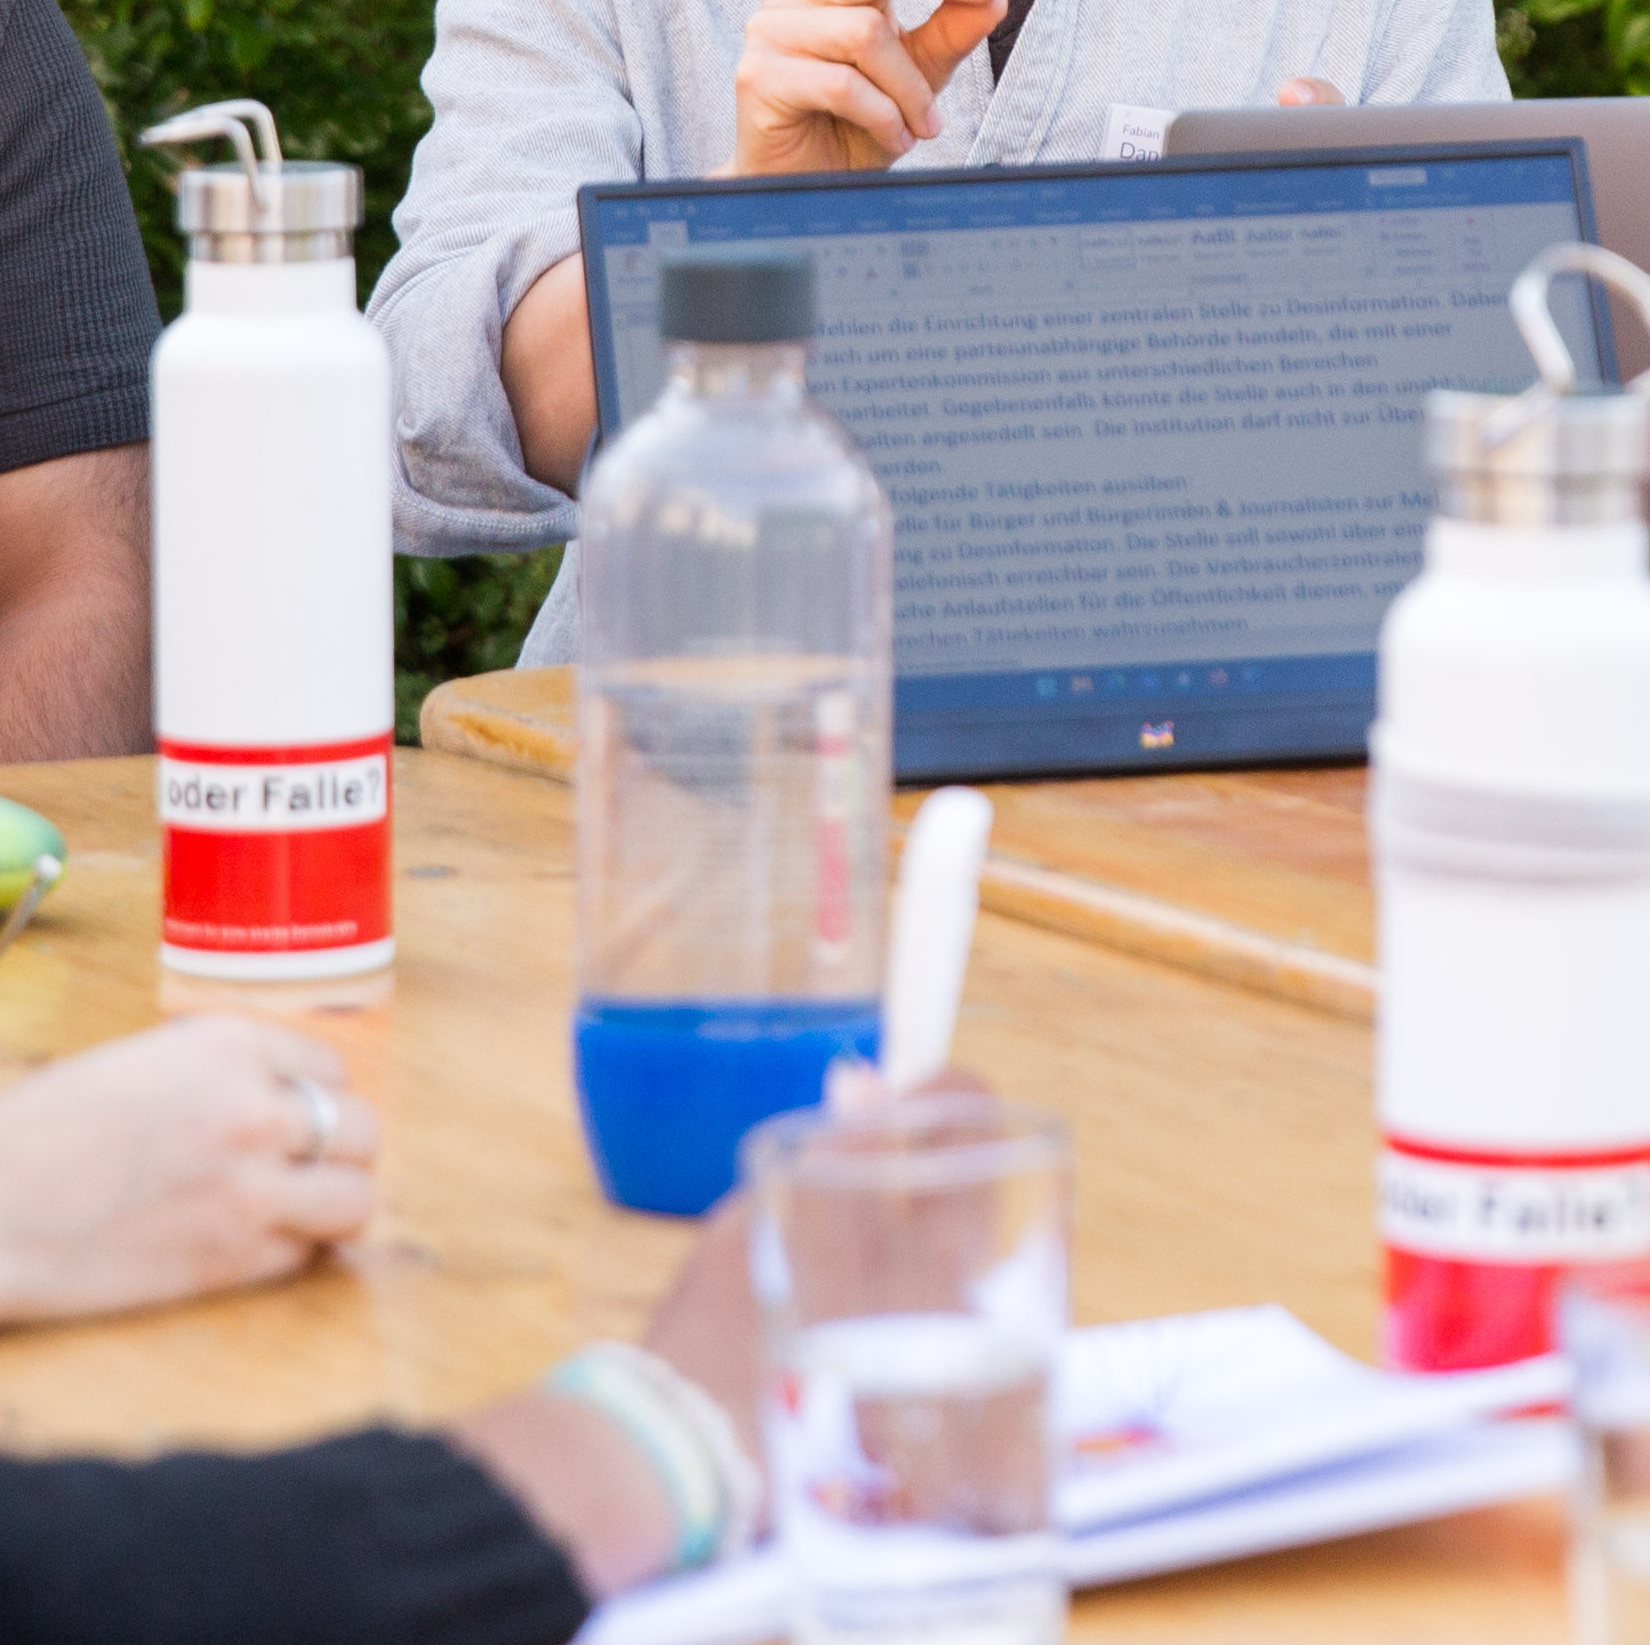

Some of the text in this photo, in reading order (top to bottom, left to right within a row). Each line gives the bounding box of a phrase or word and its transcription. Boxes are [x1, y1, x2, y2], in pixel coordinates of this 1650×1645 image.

[1123, 124, 1160, 139] Fabian
[1120, 142, 1162, 163] Dan
[818, 318, 884, 337] fehlen
[889, 317, 920, 334] die
[924, 310, 1037, 336] Einrichtung
[1043, 310, 1092, 327] einer
[1100, 304, 1193, 324] zentralen
[1199, 300, 1252, 320] Stelle
[1259, 303, 1282, 317] zu
[823, 348, 862, 366] sich
[867, 349, 899, 364] um
[905, 344, 947, 362] eine
[1147, 329, 1231, 351] Behörde
[1328, 323, 1358, 342] die
[1364, 322, 1397, 340] mit
[1402, 321, 1452, 339] einer
[843, 367, 1052, 397] Expertenkommission
[1058, 368, 1089, 383] aus
[1096, 356, 1274, 381] unterschiedlichen
[1279, 351, 1379, 373] Bereichen
[942, 392, 1096, 419] Gegebenenfalls
[1102, 388, 1172, 409] könnte
[1178, 387, 1209, 406] die
[1214, 383, 1268, 404] Stelle
[1274, 381, 1322, 401] auch
[1328, 381, 1346, 399] in
[1352, 378, 1389, 398] den
[922, 422, 1035, 448] angesiedelt
[1093, 417, 1127, 438] Die
[1240, 410, 1283, 431] darf
[1287, 407, 1337, 429] nicht
[1343, 411, 1373, 426] zur
[985, 478, 1096, 503] Tätigkeiten
[934, 514, 962, 532] für
[968, 509, 1036, 533] Bürger
[1042, 508, 1081, 527] und
[1087, 501, 1212, 528] Bürgerinnen
[1240, 493, 1359, 518] Journalisten
[1365, 496, 1394, 511] zur
[930, 547, 953, 562] zu
[1126, 532, 1160, 552] Die
[1165, 529, 1220, 550] Stelle
[1225, 528, 1260, 548] soll
[1265, 524, 1337, 546] sowohl
[1343, 522, 1388, 542] über
[895, 569, 1000, 592] elefonisch
[1006, 564, 1108, 586] erreichbar
[1166, 559, 1200, 579] Die
[942, 593, 1075, 619] Anlaufstellen
[1079, 591, 1108, 612] für
[1114, 591, 1145, 611] die
[1151, 581, 1288, 609] Öffentlichkeit
[168, 767, 381, 811] oder Falle?
